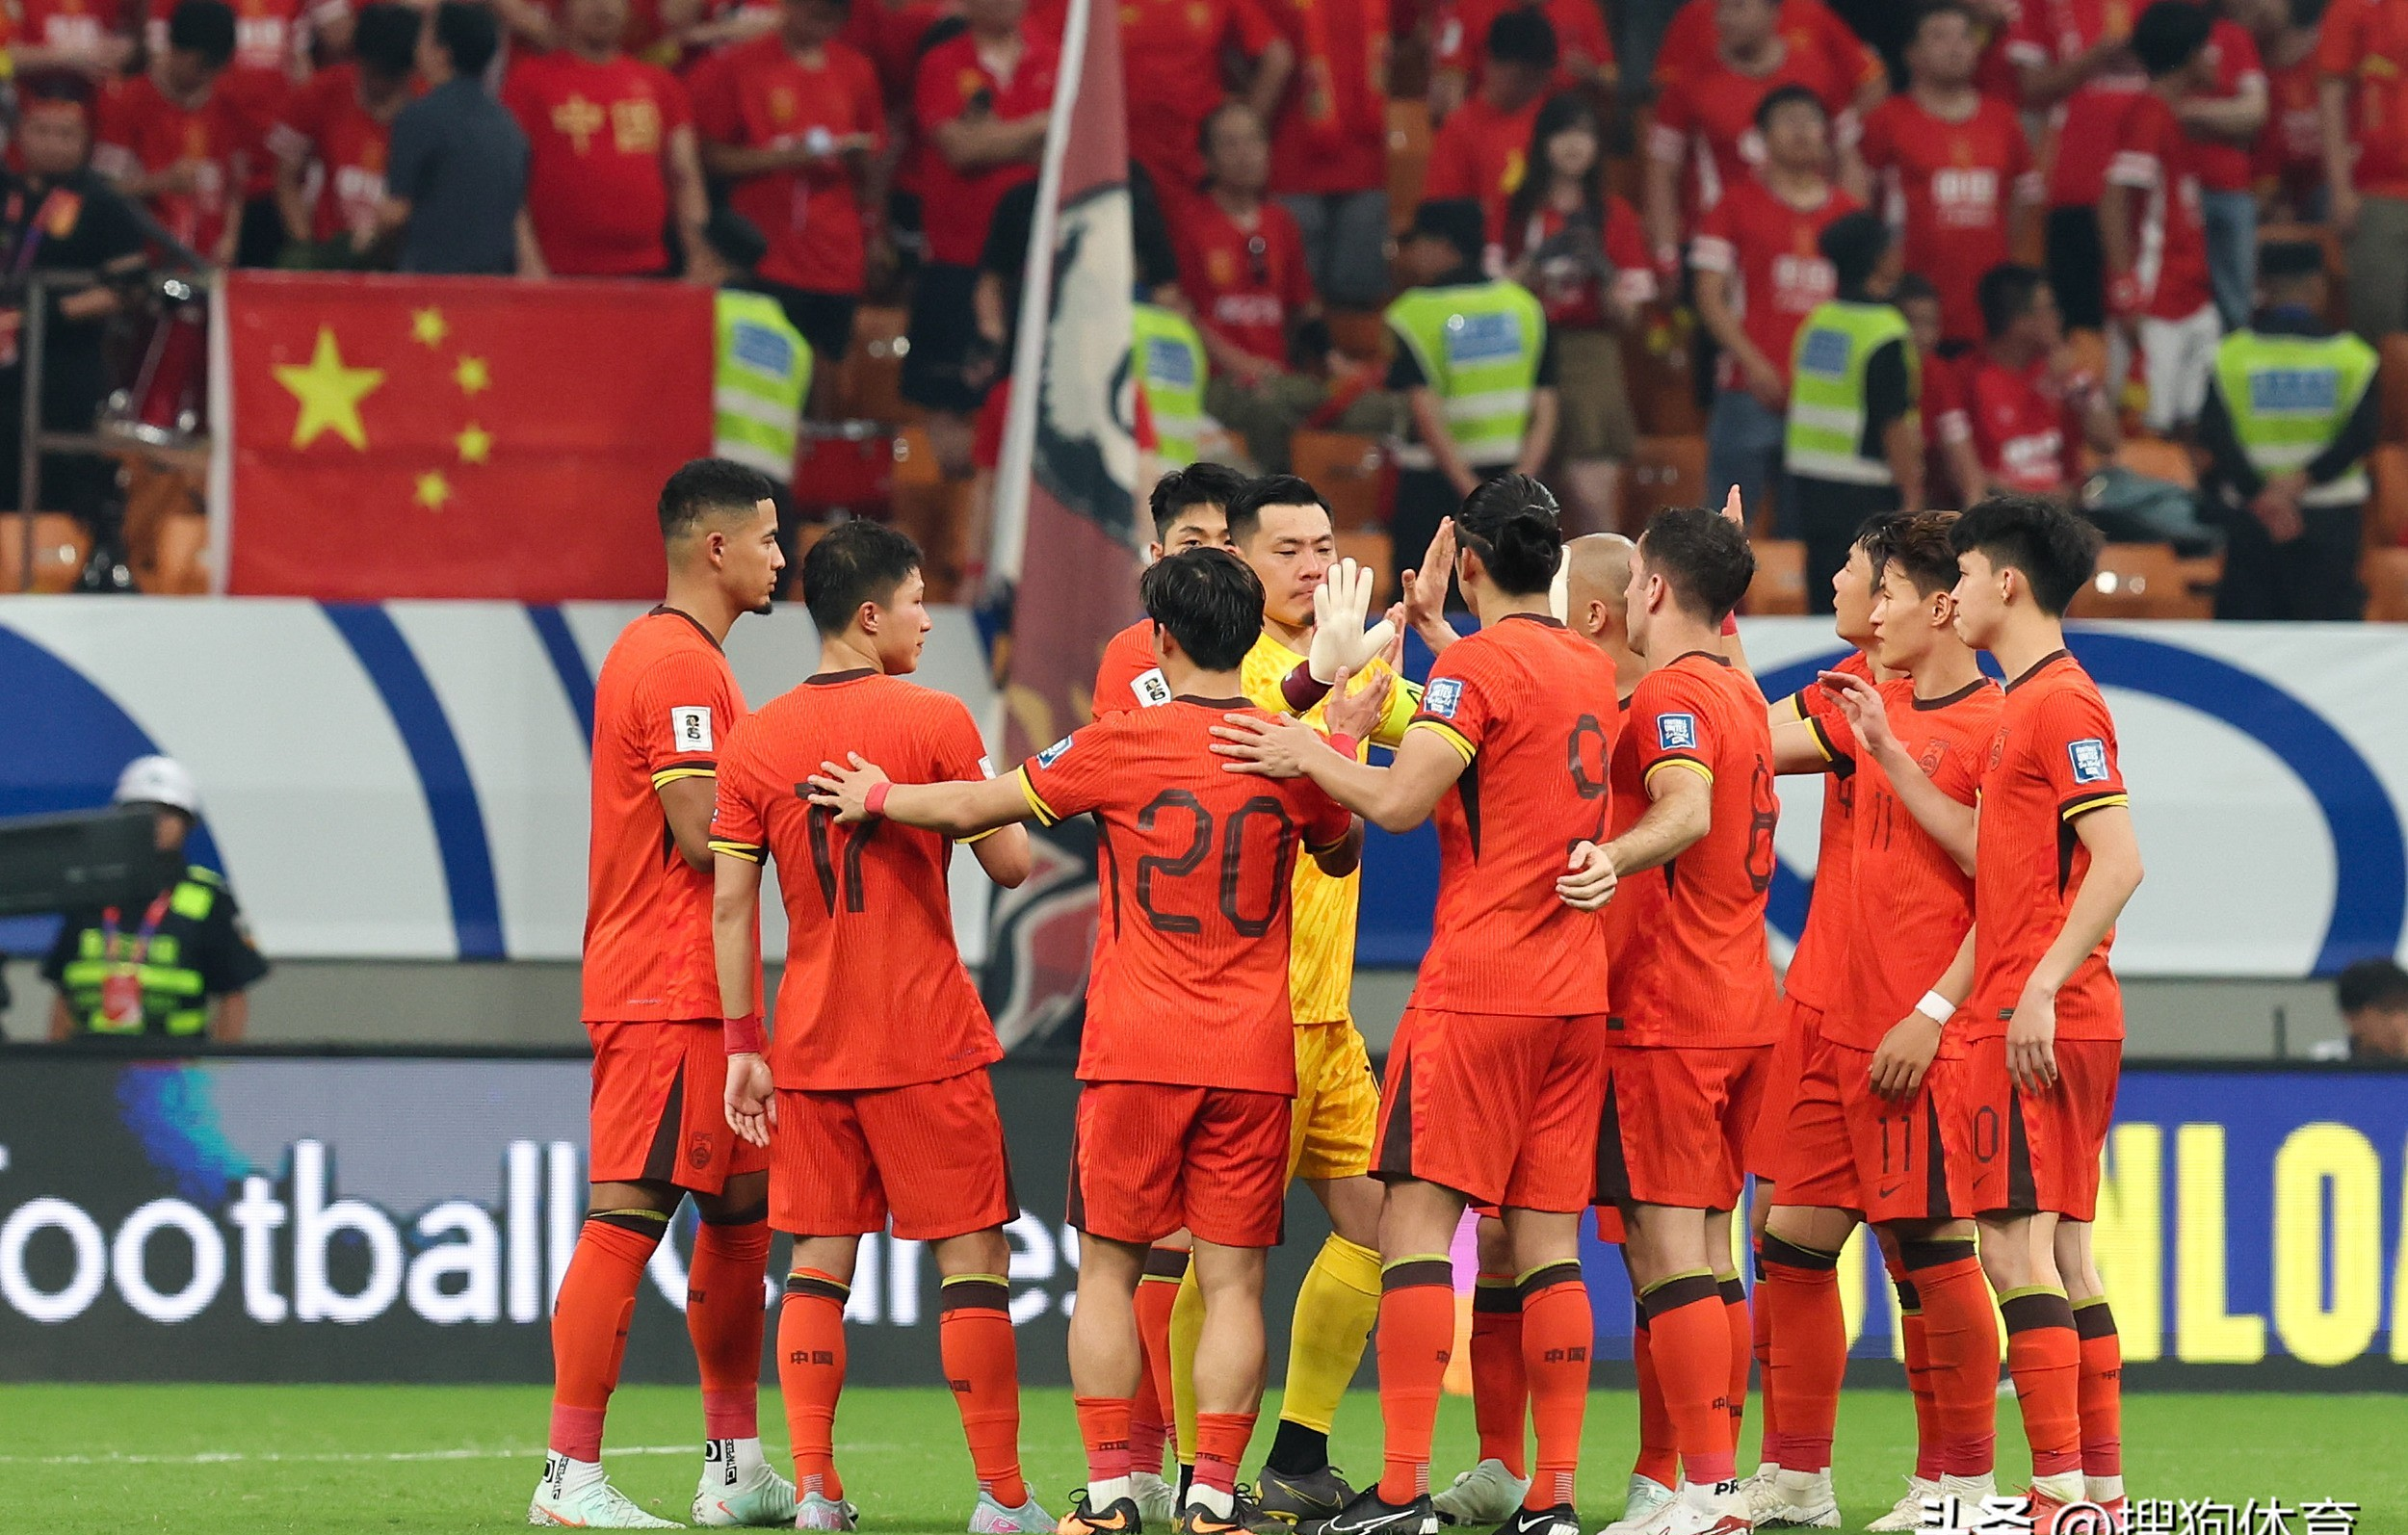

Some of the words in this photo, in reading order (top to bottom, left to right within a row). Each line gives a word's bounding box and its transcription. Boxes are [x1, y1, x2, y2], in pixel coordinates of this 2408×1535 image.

[1567, 714, 1610, 854] 9
[1745, 753, 1779, 893] 8
[1869, 791, 1894, 853] 11
[1137, 789, 1293, 938] 20
[1878, 1115, 1912, 1175] 11
[0, 1138, 581, 1324] ootball
